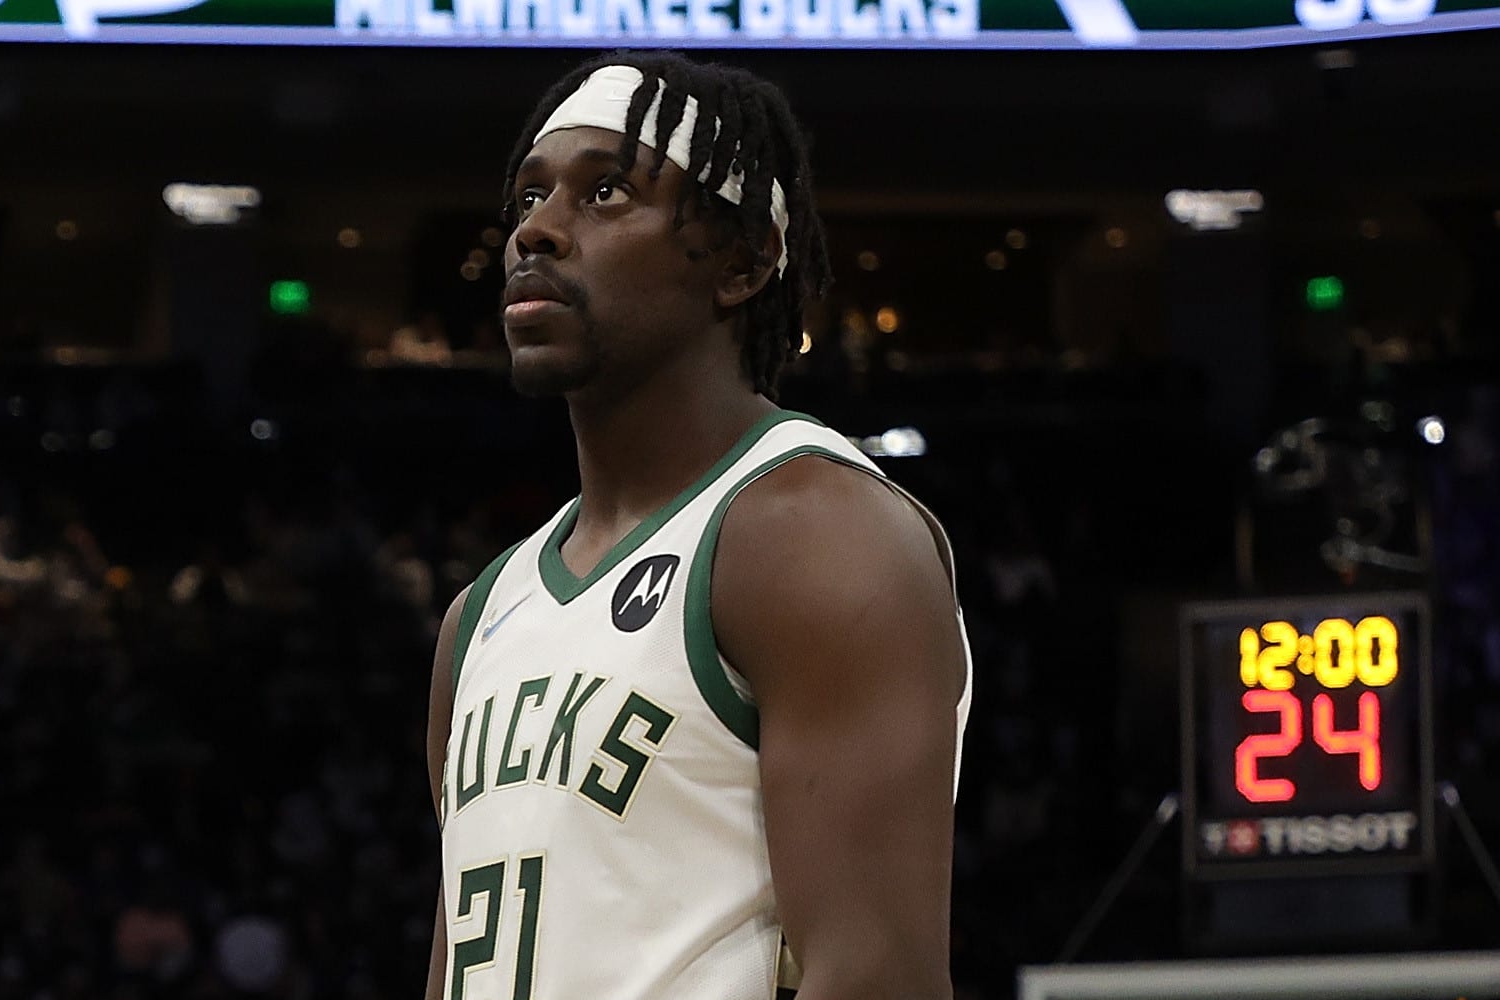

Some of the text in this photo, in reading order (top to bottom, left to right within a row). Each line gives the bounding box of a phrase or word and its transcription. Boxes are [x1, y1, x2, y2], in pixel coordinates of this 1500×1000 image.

[1239, 615, 1399, 691] 12:00
[441, 668, 682, 824] UCKS
[1234, 690, 1382, 802] 24
